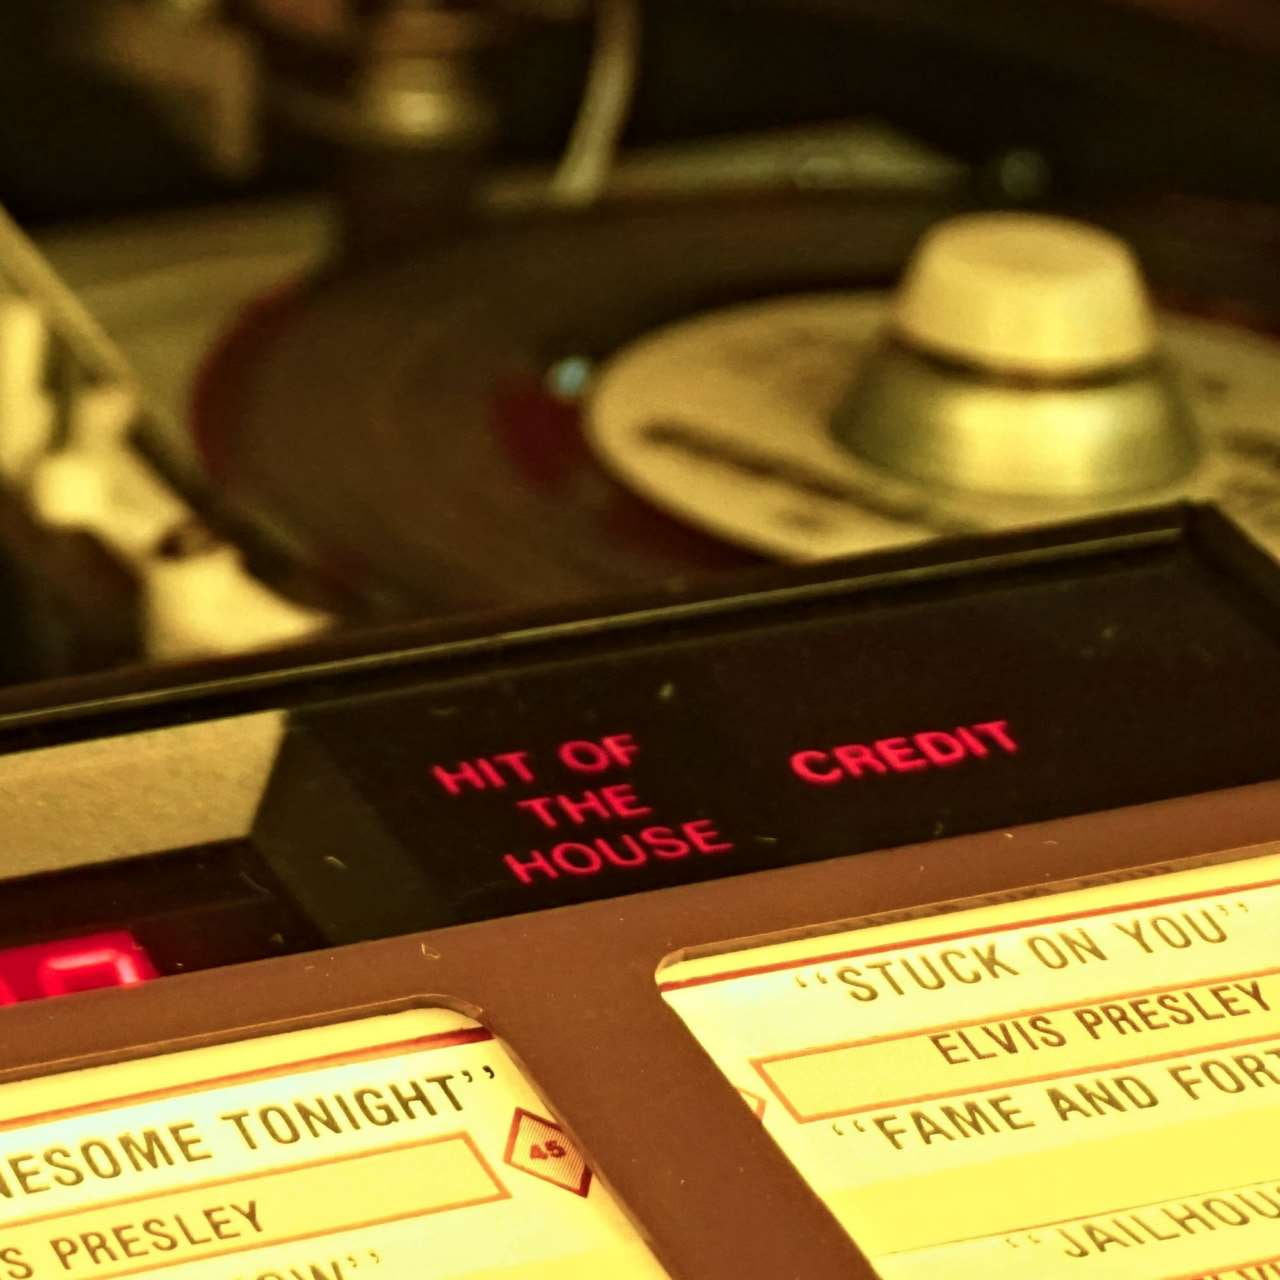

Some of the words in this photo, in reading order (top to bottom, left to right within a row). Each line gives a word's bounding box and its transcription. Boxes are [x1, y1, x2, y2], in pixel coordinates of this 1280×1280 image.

[431, 750, 537, 796] HIT
[557, 733, 642, 774] OF
[789, 719, 1019, 785] CREDIT
[517, 783, 653, 831] THE
[503, 819, 736, 886] HOUSE
[1031, 926, 1109, 971] ON
[929, 1014, 1068, 1066] ELVIS
[1074, 979, 1272, 1041] PRESLEY
[1045, 1074, 1159, 1122] AND
[529, 1140, 567, 1161] 45
[49, 1200, 266, 1273] PRESLEY
[1004, 1186, 1280, 1258] “JAILHOU
